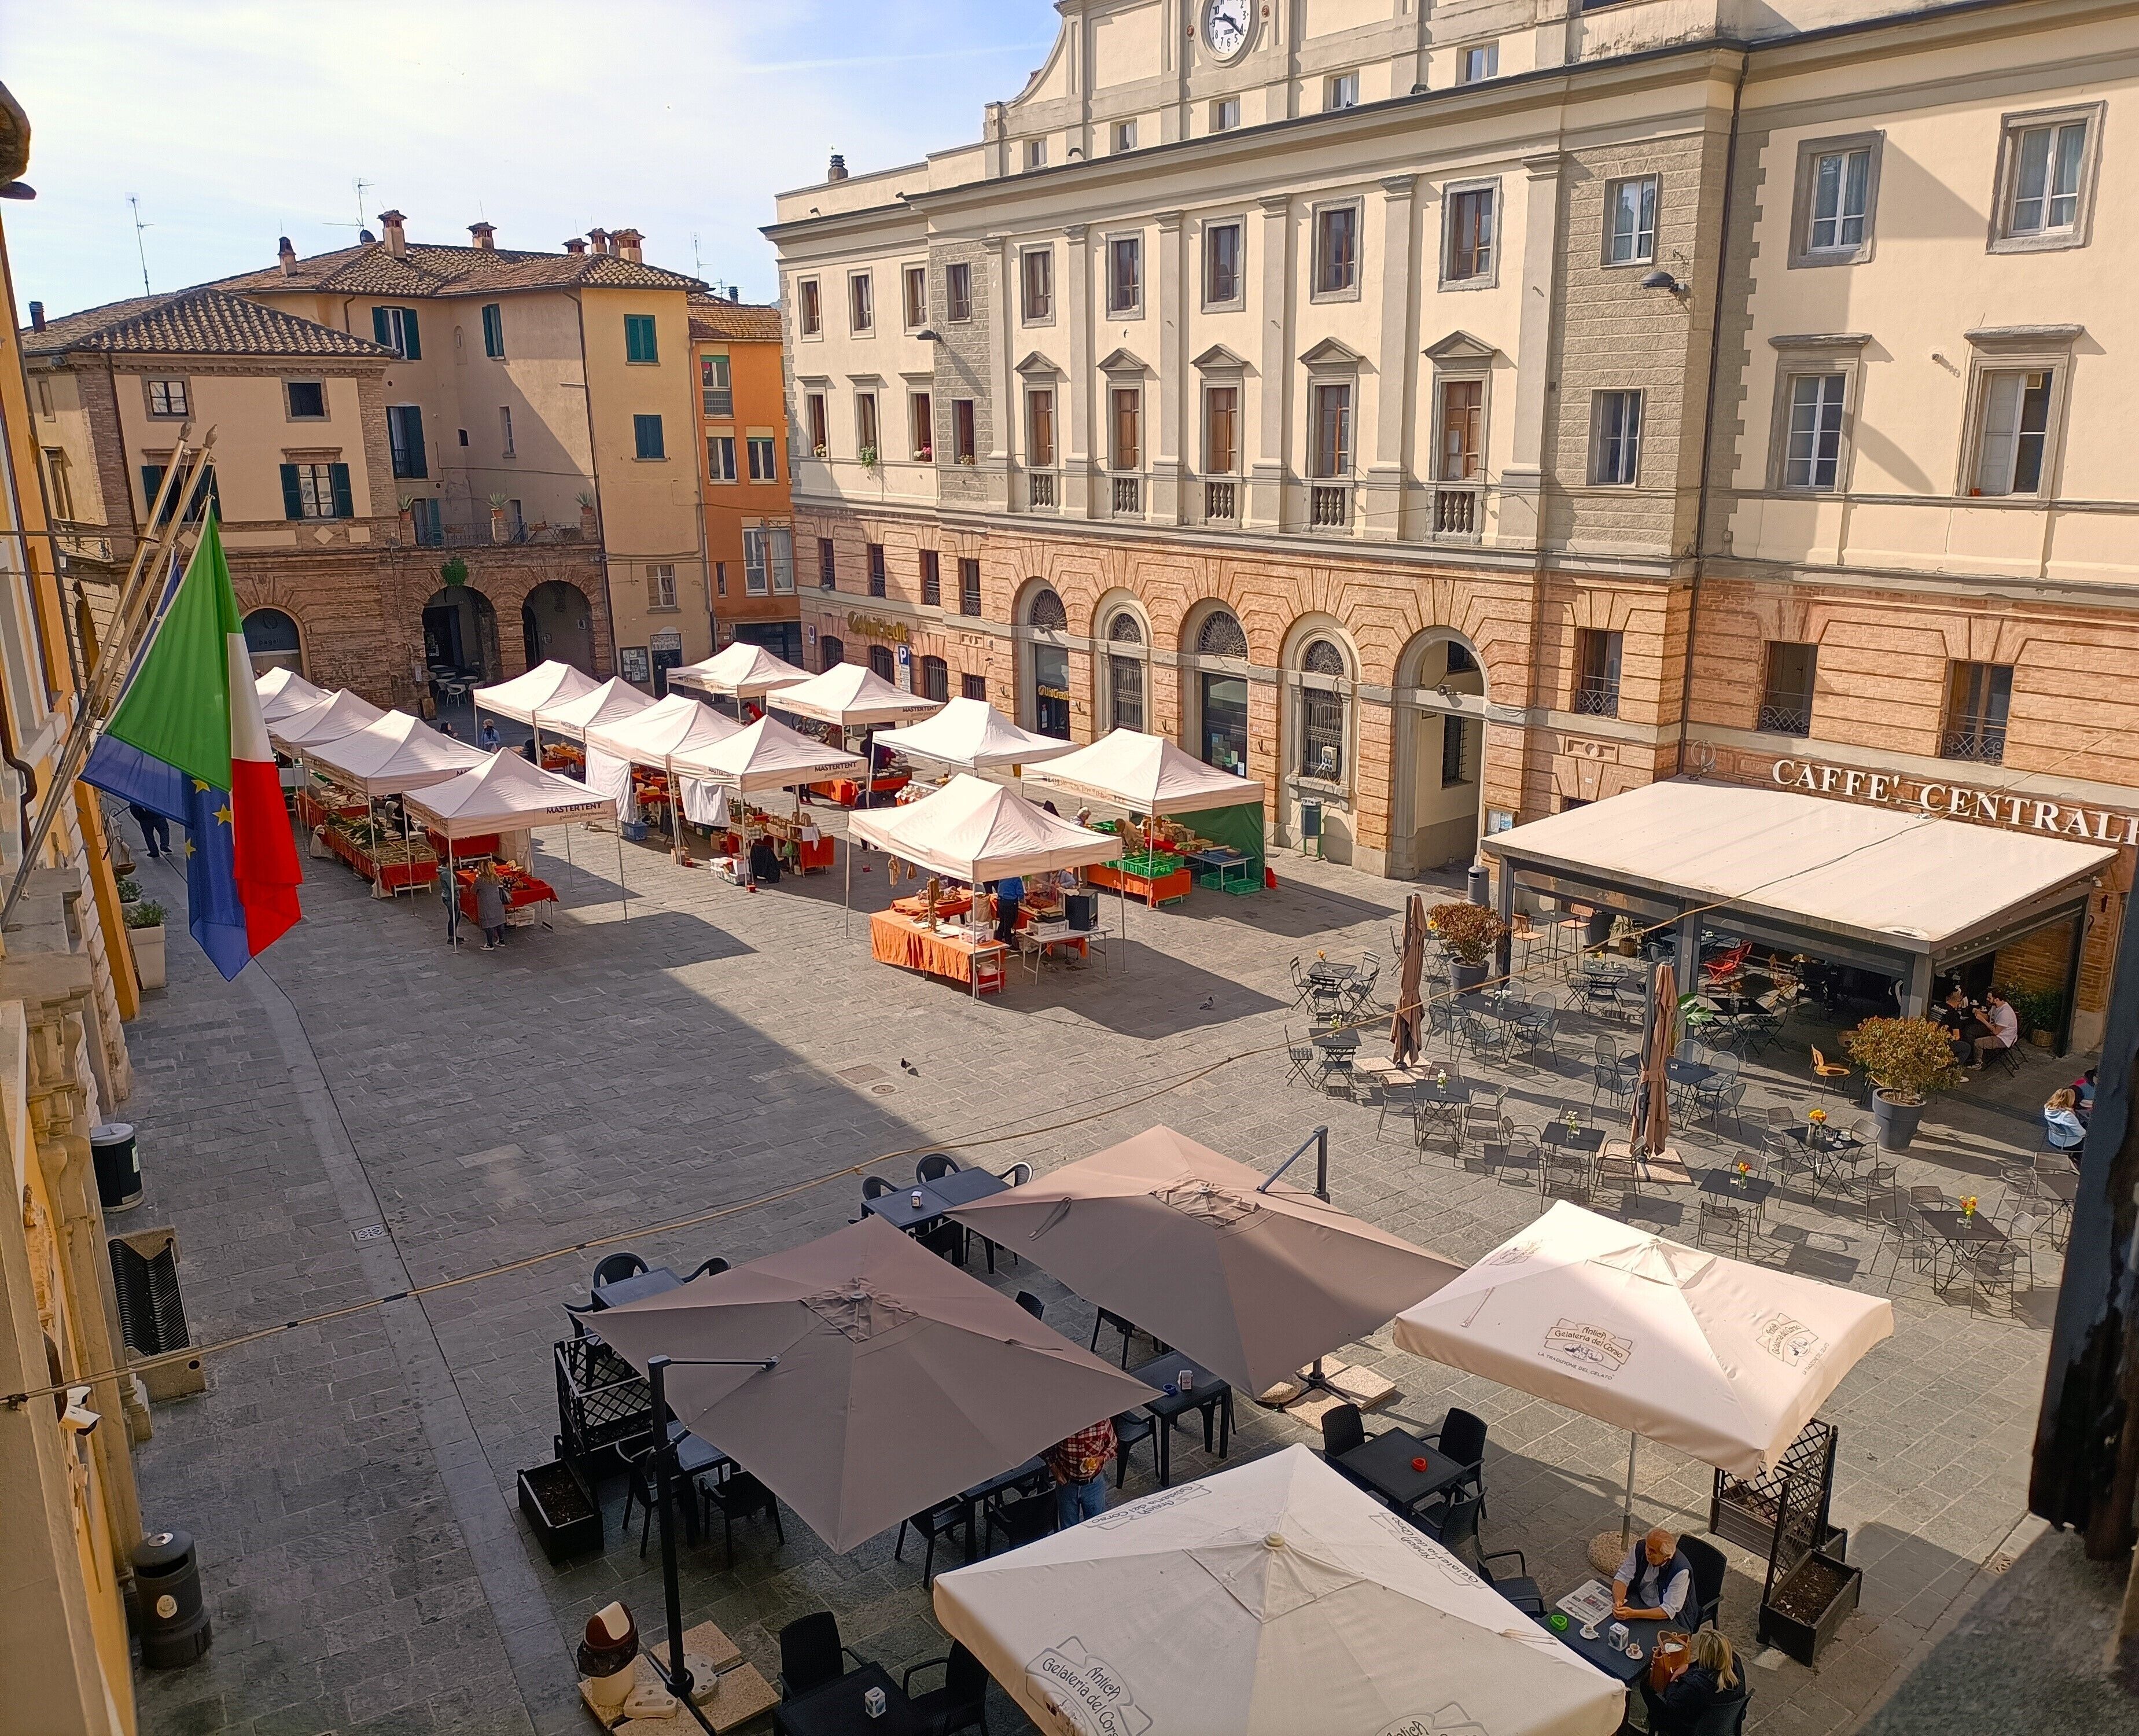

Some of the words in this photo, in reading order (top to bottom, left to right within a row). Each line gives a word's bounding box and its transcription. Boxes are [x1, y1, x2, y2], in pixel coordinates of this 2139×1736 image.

[1214, 5, 1219, 15] 10
[1242, 10, 1246, 20] 3
[1212, 17, 1216, 27] 9
[1215, 30, 1218, 39] 8
[1234, 34, 1238, 43] 5
[1220, 37, 1224, 46] 7
[1227, 38, 1231, 47] 6
[900, 647, 907, 663] P
[815, 762, 857, 772] MASTERTENT
[1772, 759, 1901, 803] CAFFE'
[546, 802, 602, 814] MASTERTENT
[1554, 1330, 1591, 1342] Gelateria
[1591, 1338, 1604, 1347] del
[1603, 1343, 1623, 1358] Corso
[1546, 1354, 1578, 1369] TRADIZIONE
[1590, 1370, 1613, 1380] GELATO
[1042, 1657, 1090, 1698] Gelateria
[1086, 1694, 1108, 1715] del
